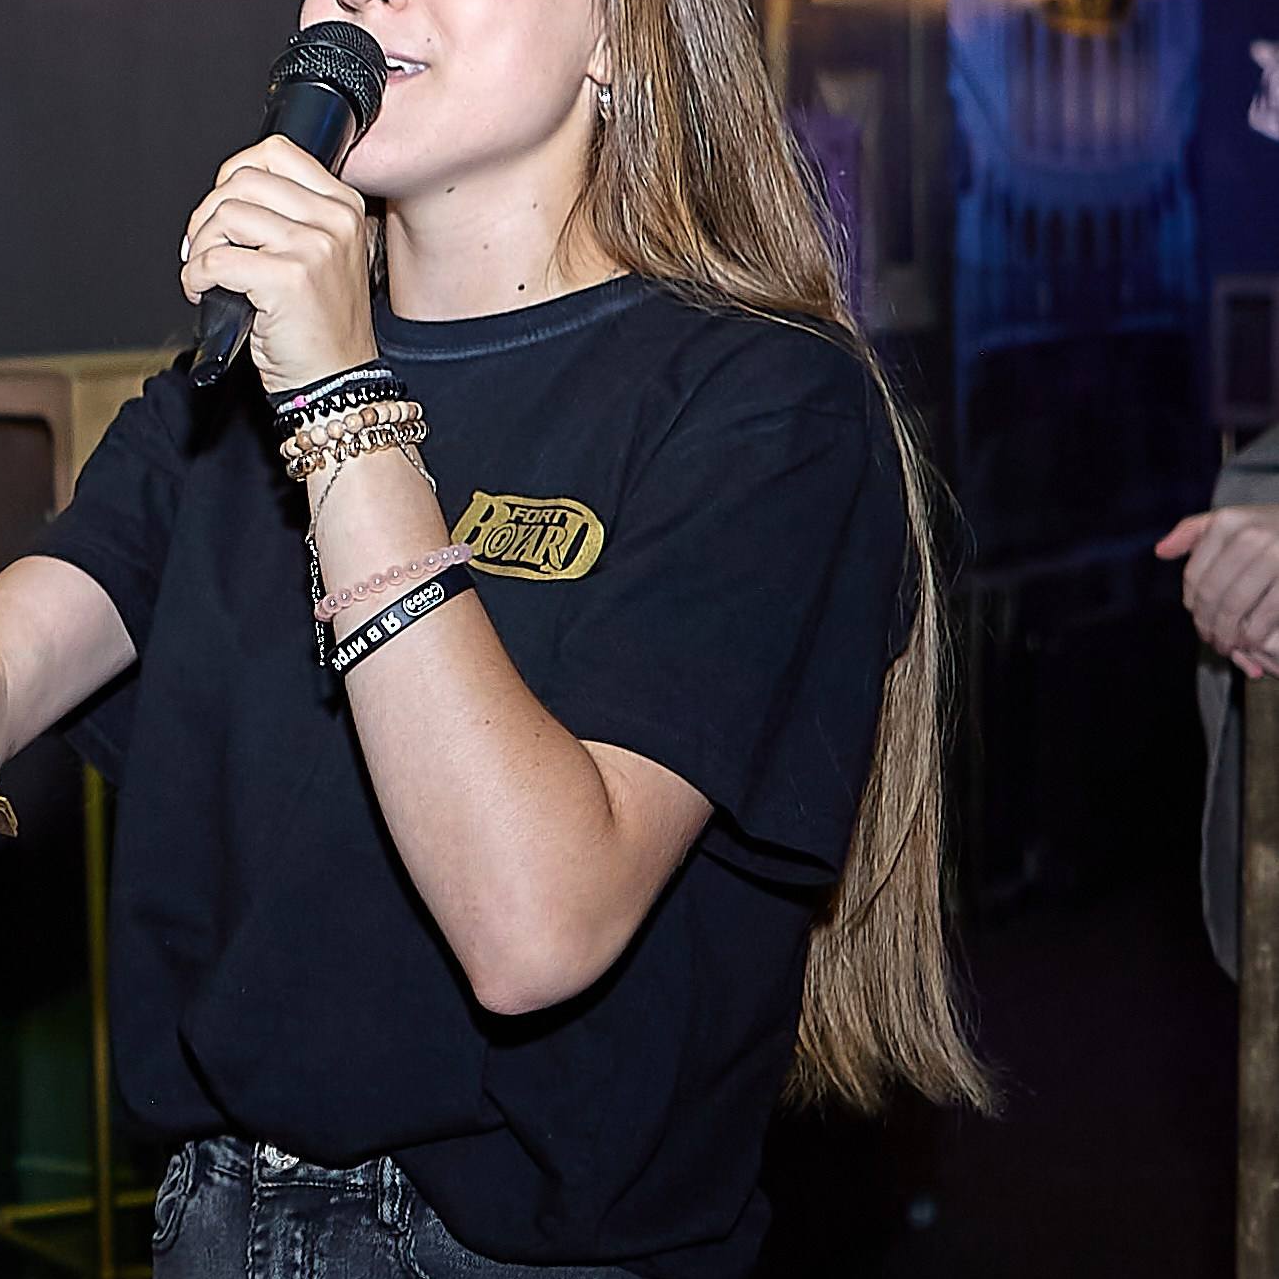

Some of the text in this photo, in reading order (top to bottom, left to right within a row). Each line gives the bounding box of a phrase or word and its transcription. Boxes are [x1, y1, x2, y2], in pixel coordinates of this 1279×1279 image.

[510, 506, 568, 524] FORT
[450, 490, 605, 581] BOYARD
[380, 611, 402, 635] Я
